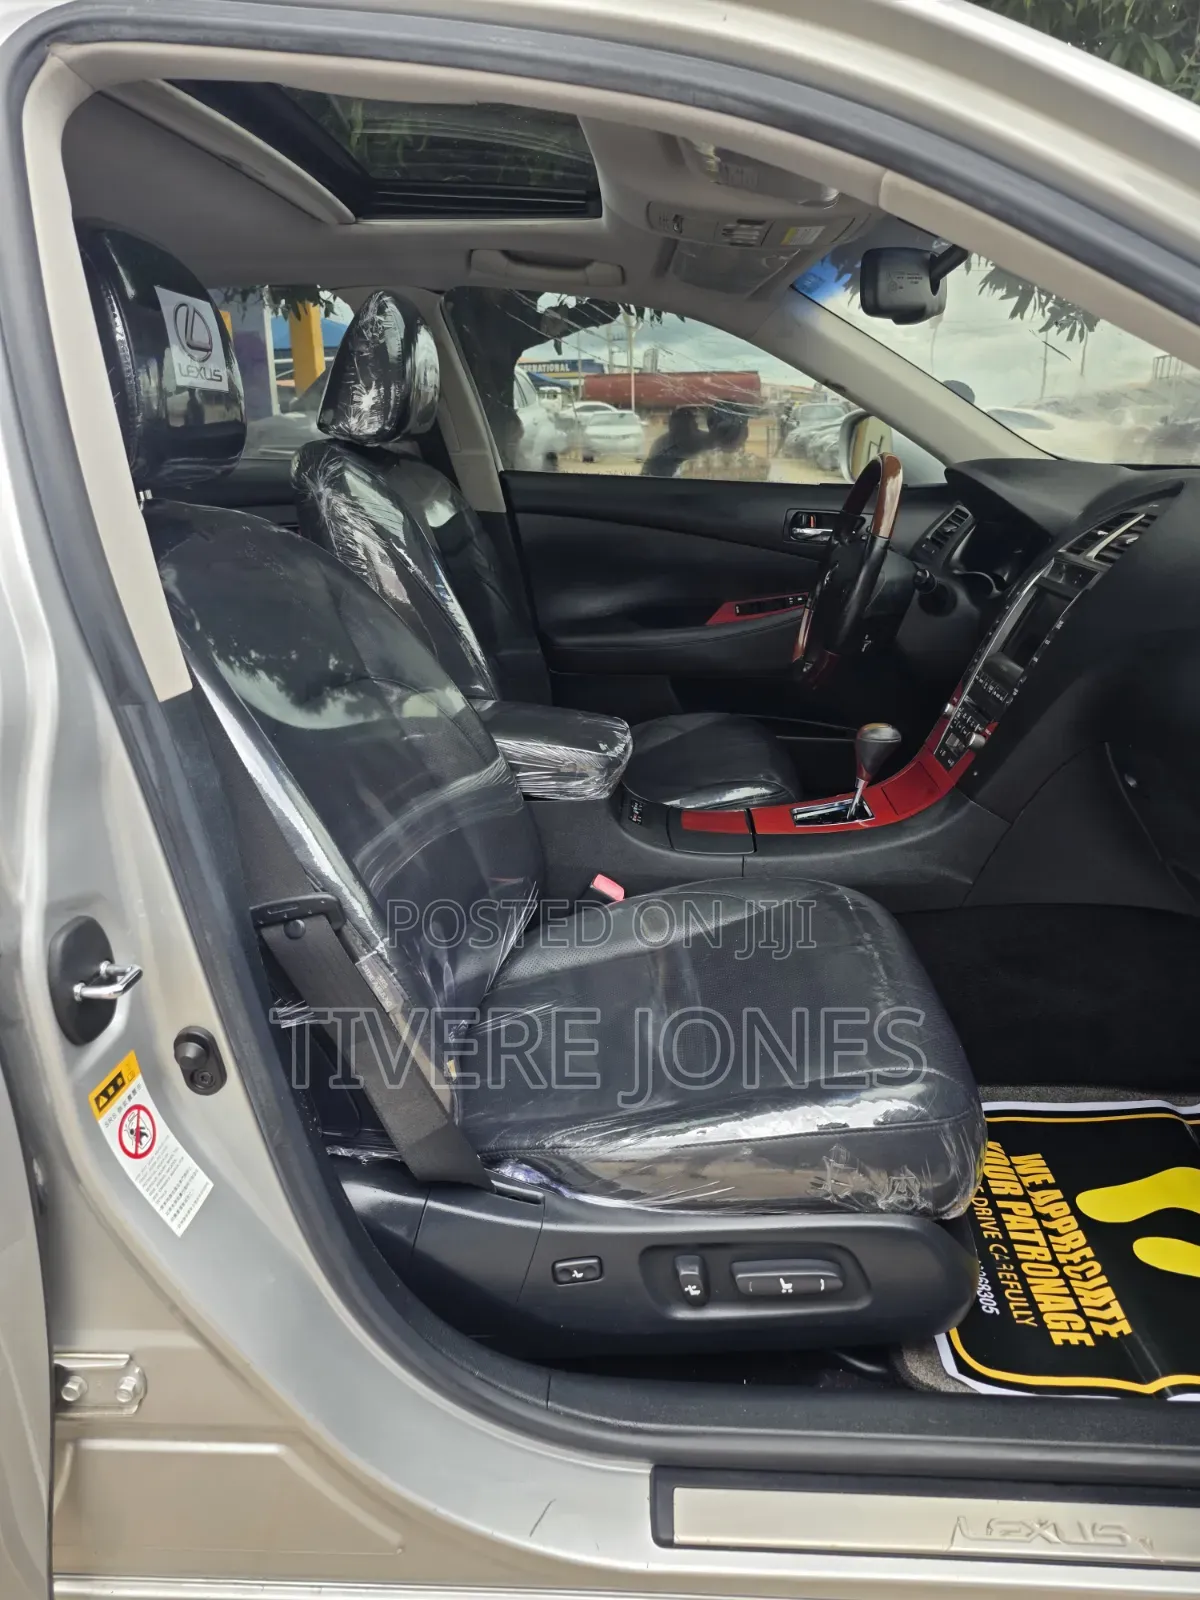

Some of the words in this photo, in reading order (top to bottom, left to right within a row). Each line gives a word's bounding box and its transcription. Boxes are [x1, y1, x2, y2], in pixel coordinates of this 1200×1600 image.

[178, 362, 223, 382] LEXUS
[521, 363, 570, 372] ERNATIONAL
[361, 964, 375, 982] SIDE
[372, 980, 393, 1008] AIRBAG
[983, 1140, 1024, 1195] YOUR
[1009, 1153, 1056, 1188] WE
[971, 1197, 1003, 1239] DRIVE
[996, 1200, 1095, 1346] PATRONAGE
[1027, 1189, 1133, 1338] APPRECIATE
[977, 1260, 1000, 1316] 68305
[951, 1515, 1132, 1548] LEXUS
